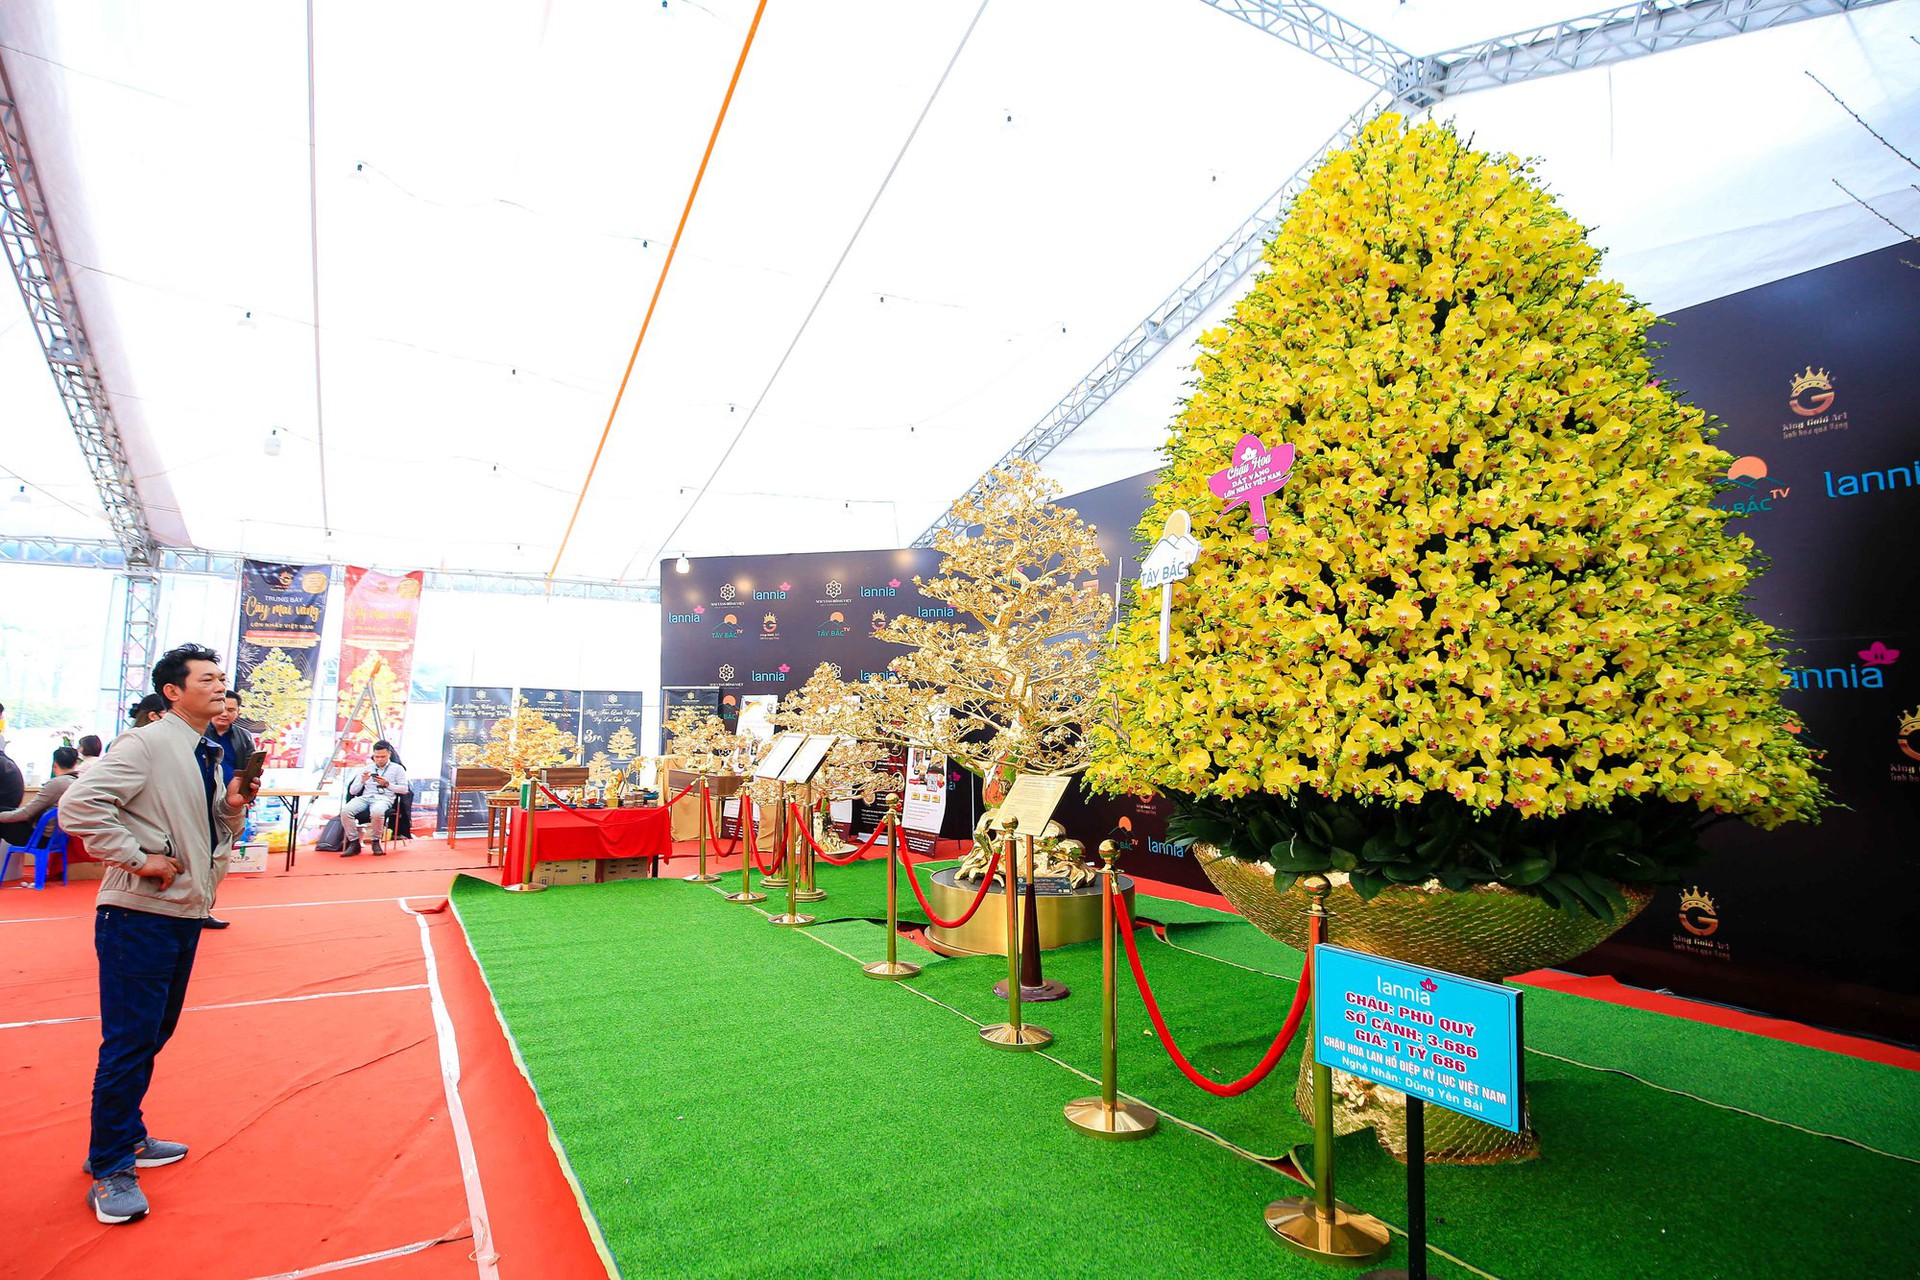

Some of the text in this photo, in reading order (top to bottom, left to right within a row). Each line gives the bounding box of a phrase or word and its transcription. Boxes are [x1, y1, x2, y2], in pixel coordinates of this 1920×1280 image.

[1252, 454, 1272, 470] Hoa
[1268, 471, 1280, 480] NAM
[1770, 487, 1790, 500] TV
[1142, 568, 1160, 586] TÂY
[753, 589, 786, 600] lannia
[860, 586, 896, 597] lannia
[668, 612, 700, 623] lannia
[918, 606, 954, 618] lannia
[752, 671, 786, 682] lannia
[1781, 664, 1884, 689] annia
[1378, 976, 1430, 1006] lannia
[1345, 991, 1394, 1016] CHẬU:
[1345, 1010, 1367, 1025] SỐ
[1427, 1034, 1478, 1059] 3.686
[1354, 1029, 1467, 1073] GIÁ: 1 TỶ 686
[1324, 1036, 1346, 1051] CHẬU
[1348, 1043, 1364, 1058] HOA
[1366, 1049, 1383, 1064] LAN
[1400, 1060, 1420, 1076] ĐIỆP
[1438, 1072, 1456, 1088] LỤC
[1458, 1078, 1480, 1096] VIỆT
[1482, 1086, 1507, 1105] NAM
[1342, 1056, 1368, 1073] Nghệ
[1371, 1066, 1402, 1084] Nhân:
[1438, 1088, 1460, 1104] Yên
[1464, 1097, 1483, 1112] Bái
